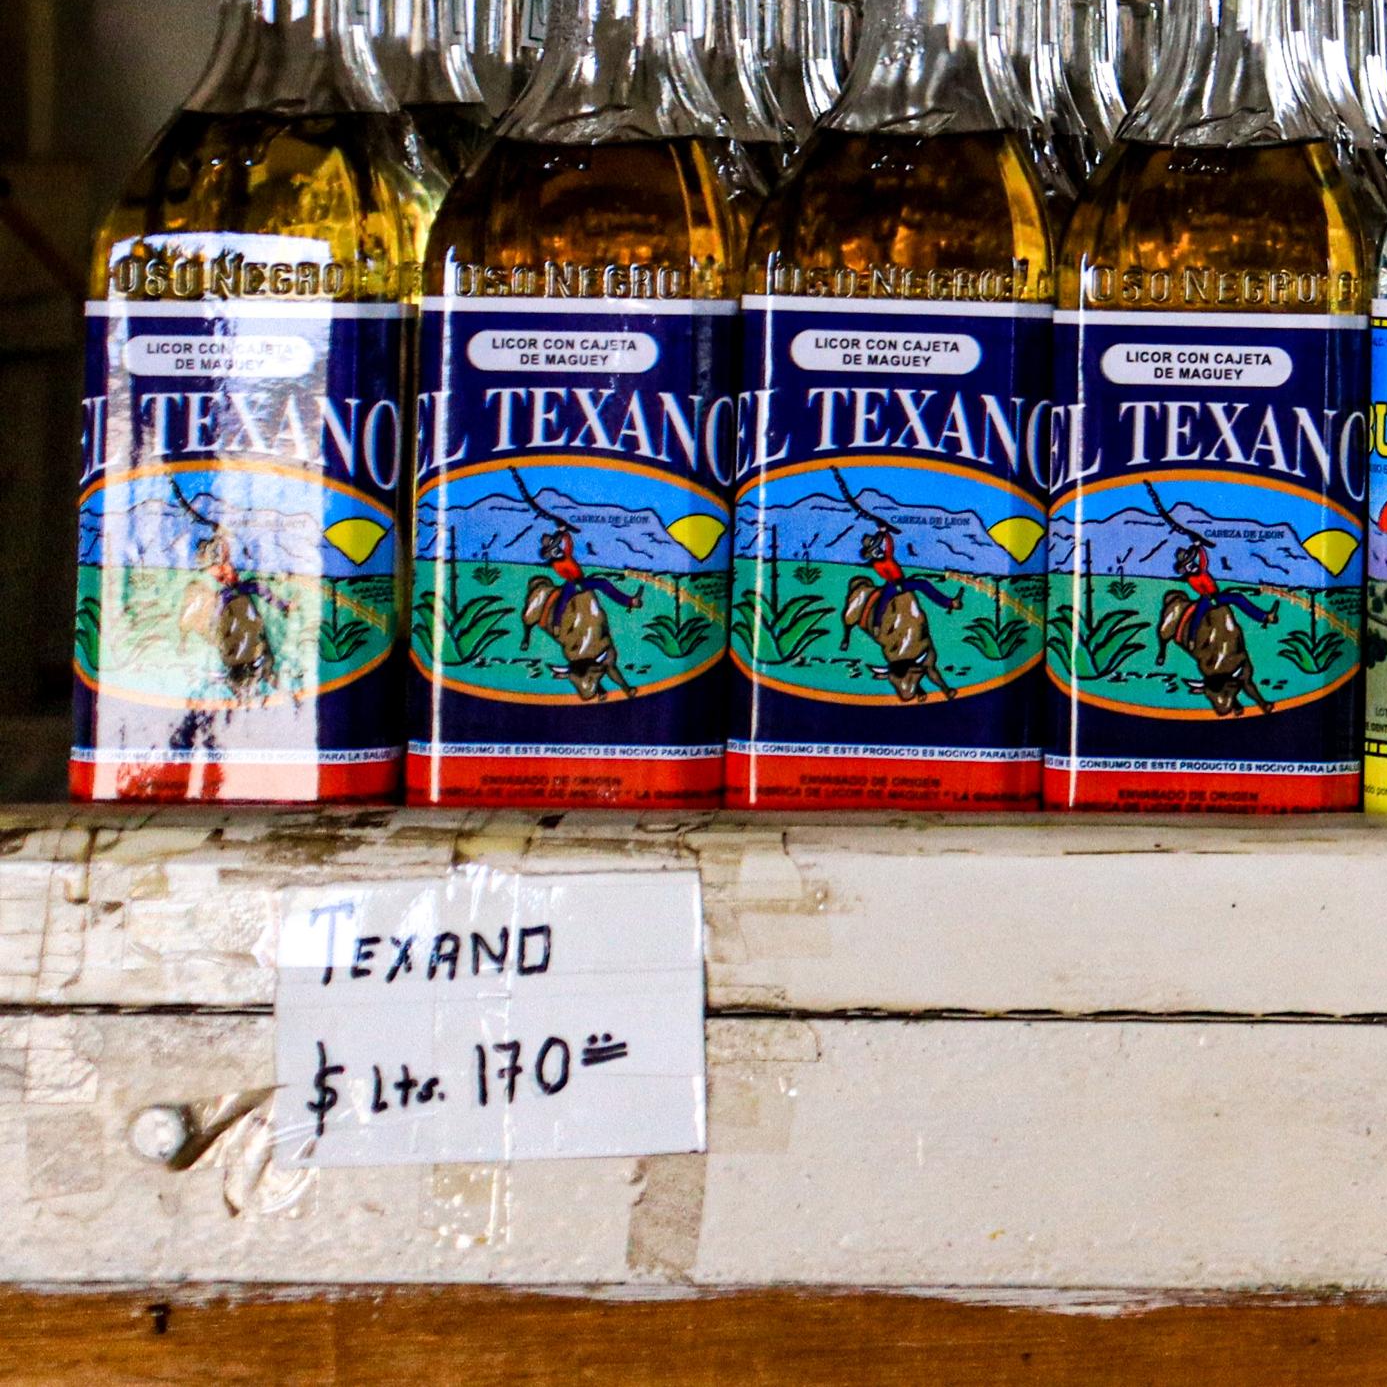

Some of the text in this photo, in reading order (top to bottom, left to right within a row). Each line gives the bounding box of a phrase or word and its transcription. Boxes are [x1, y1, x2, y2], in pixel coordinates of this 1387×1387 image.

[147, 343, 192, 354] LICOR
[492, 337, 636, 351] LICOR CON CAJETA
[815, 337, 959, 352] LICOR CON CAJETA
[175, 358, 194, 370] DE
[520, 353, 609, 366] DE MAGUEY
[843, 354, 931, 367] DE MAGUEY
[1126, 351, 1272, 366] LICOR CON CAJETA
[1154, 368, 1243, 380] DE MAGUEY
[142, 393, 401, 490] TEXANO
[485, 387, 735, 486] TEXANO
[1050, 401, 1366, 501] EL TEXANO
[310, 901, 551, 985] TEXANO
